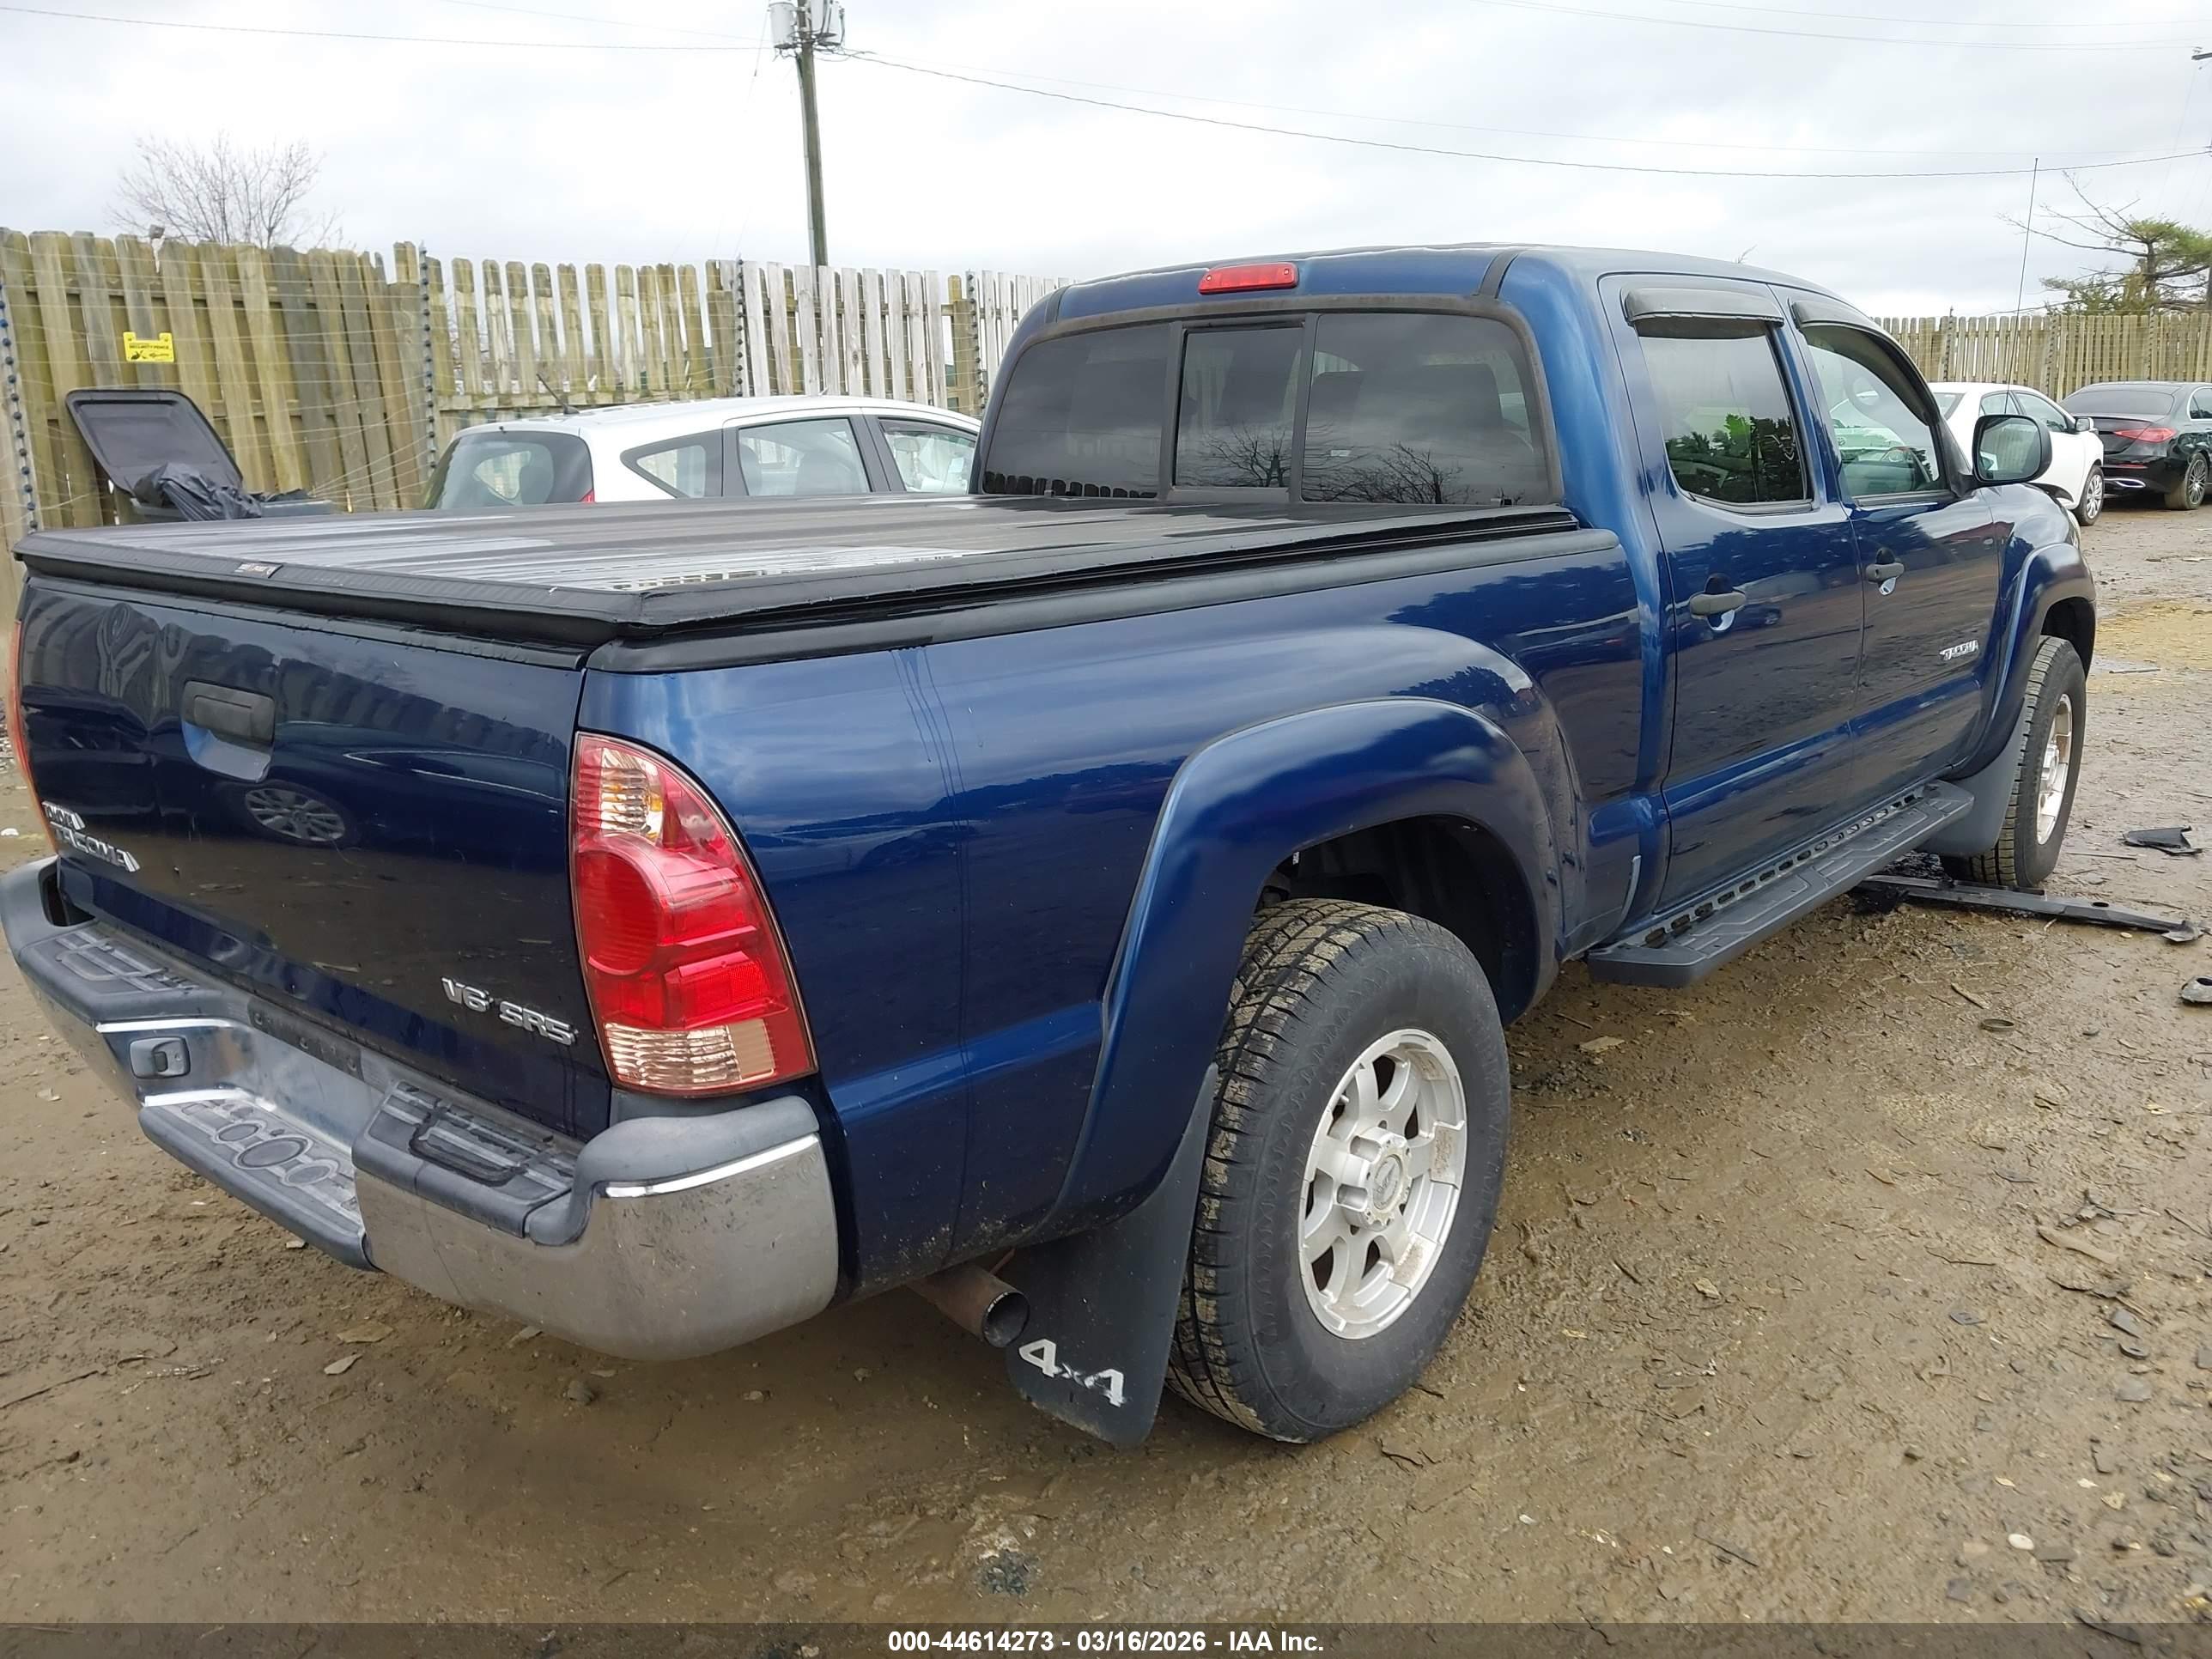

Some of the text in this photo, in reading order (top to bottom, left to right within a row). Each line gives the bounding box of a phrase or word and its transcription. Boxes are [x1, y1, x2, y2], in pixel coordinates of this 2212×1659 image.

[50, 821, 141, 872] TACOMA
[441, 977, 576, 1046] V6 SR5
